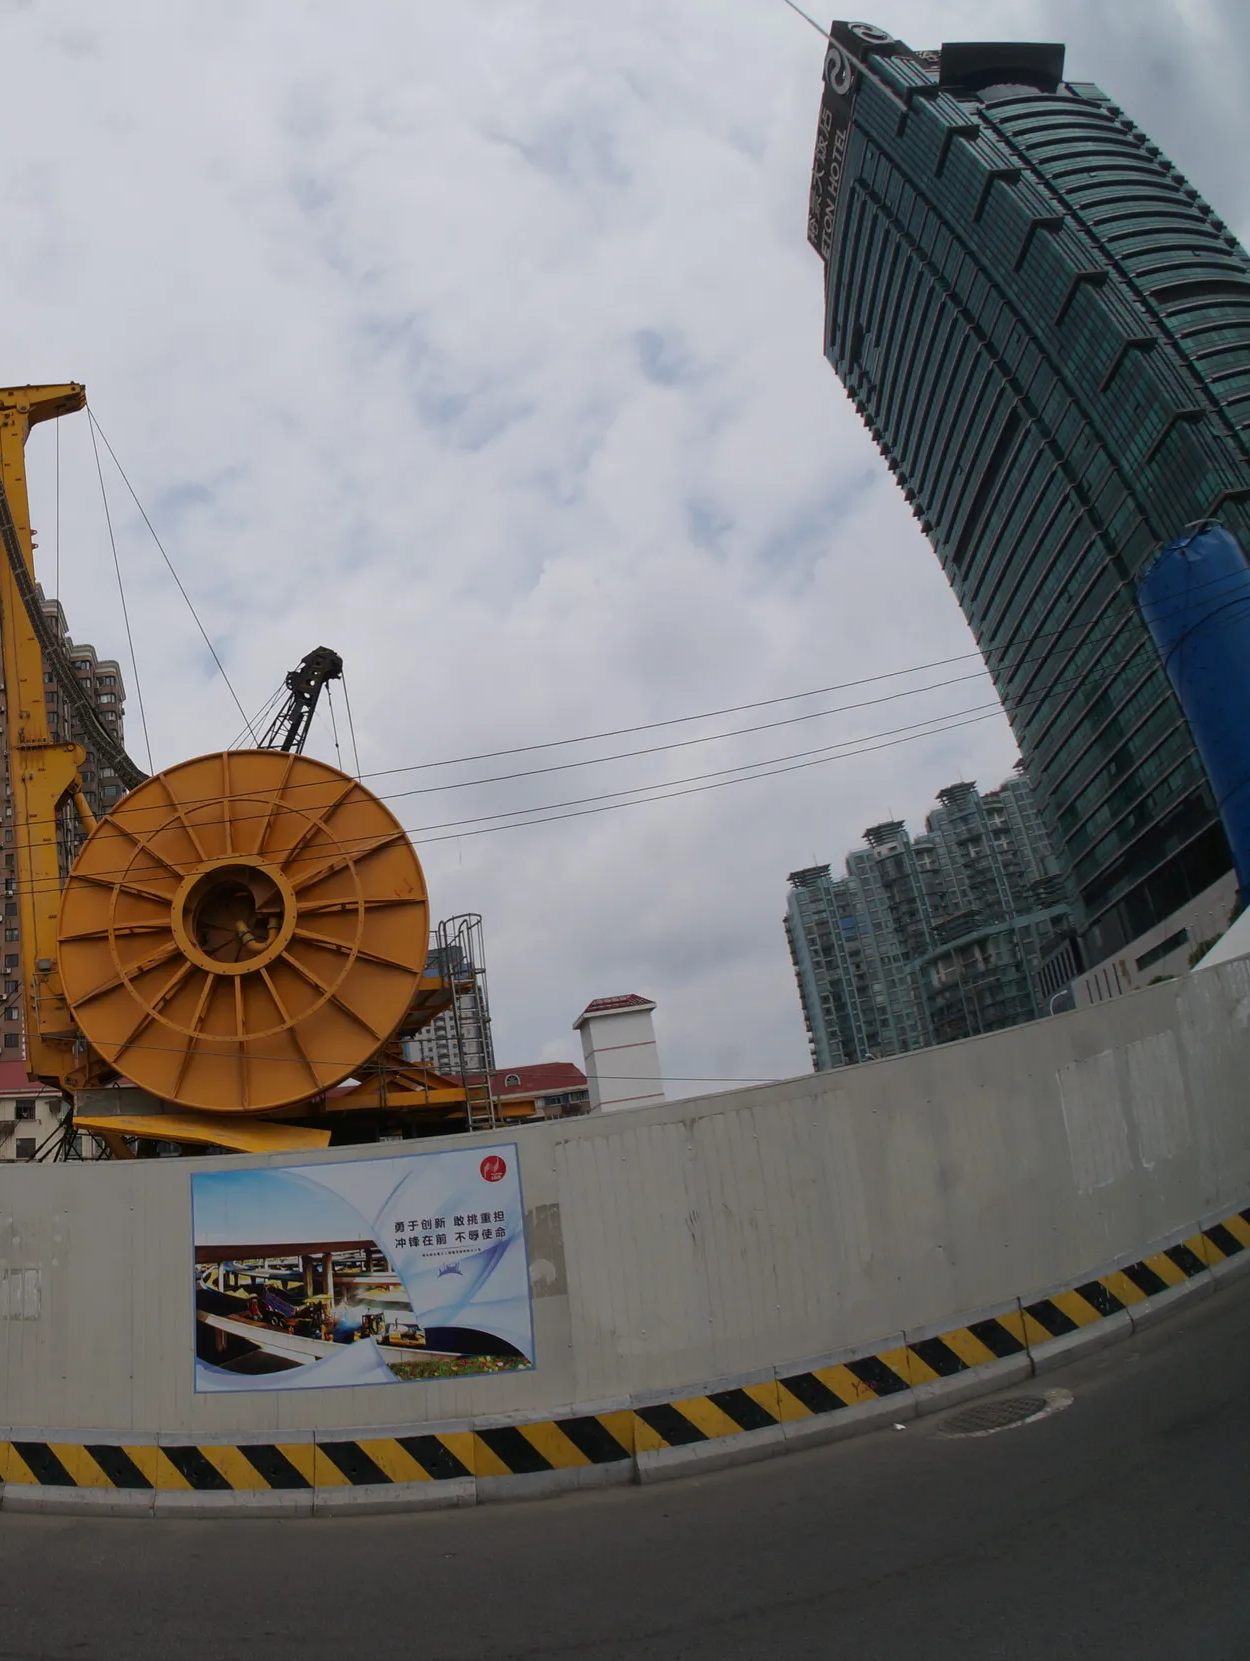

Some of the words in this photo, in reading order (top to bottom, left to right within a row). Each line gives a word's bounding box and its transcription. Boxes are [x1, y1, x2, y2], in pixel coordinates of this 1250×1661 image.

[820, 198, 836, 259] ETON
[828, 129, 847, 196] HOTEL
[394, 1217, 446, 1233] 勇于创新
[453, 1211, 505, 1226] 敢挑重担
[394, 1234, 447, 1248] 冲锋在前
[454, 1227, 506, 1243] 不辱使命
